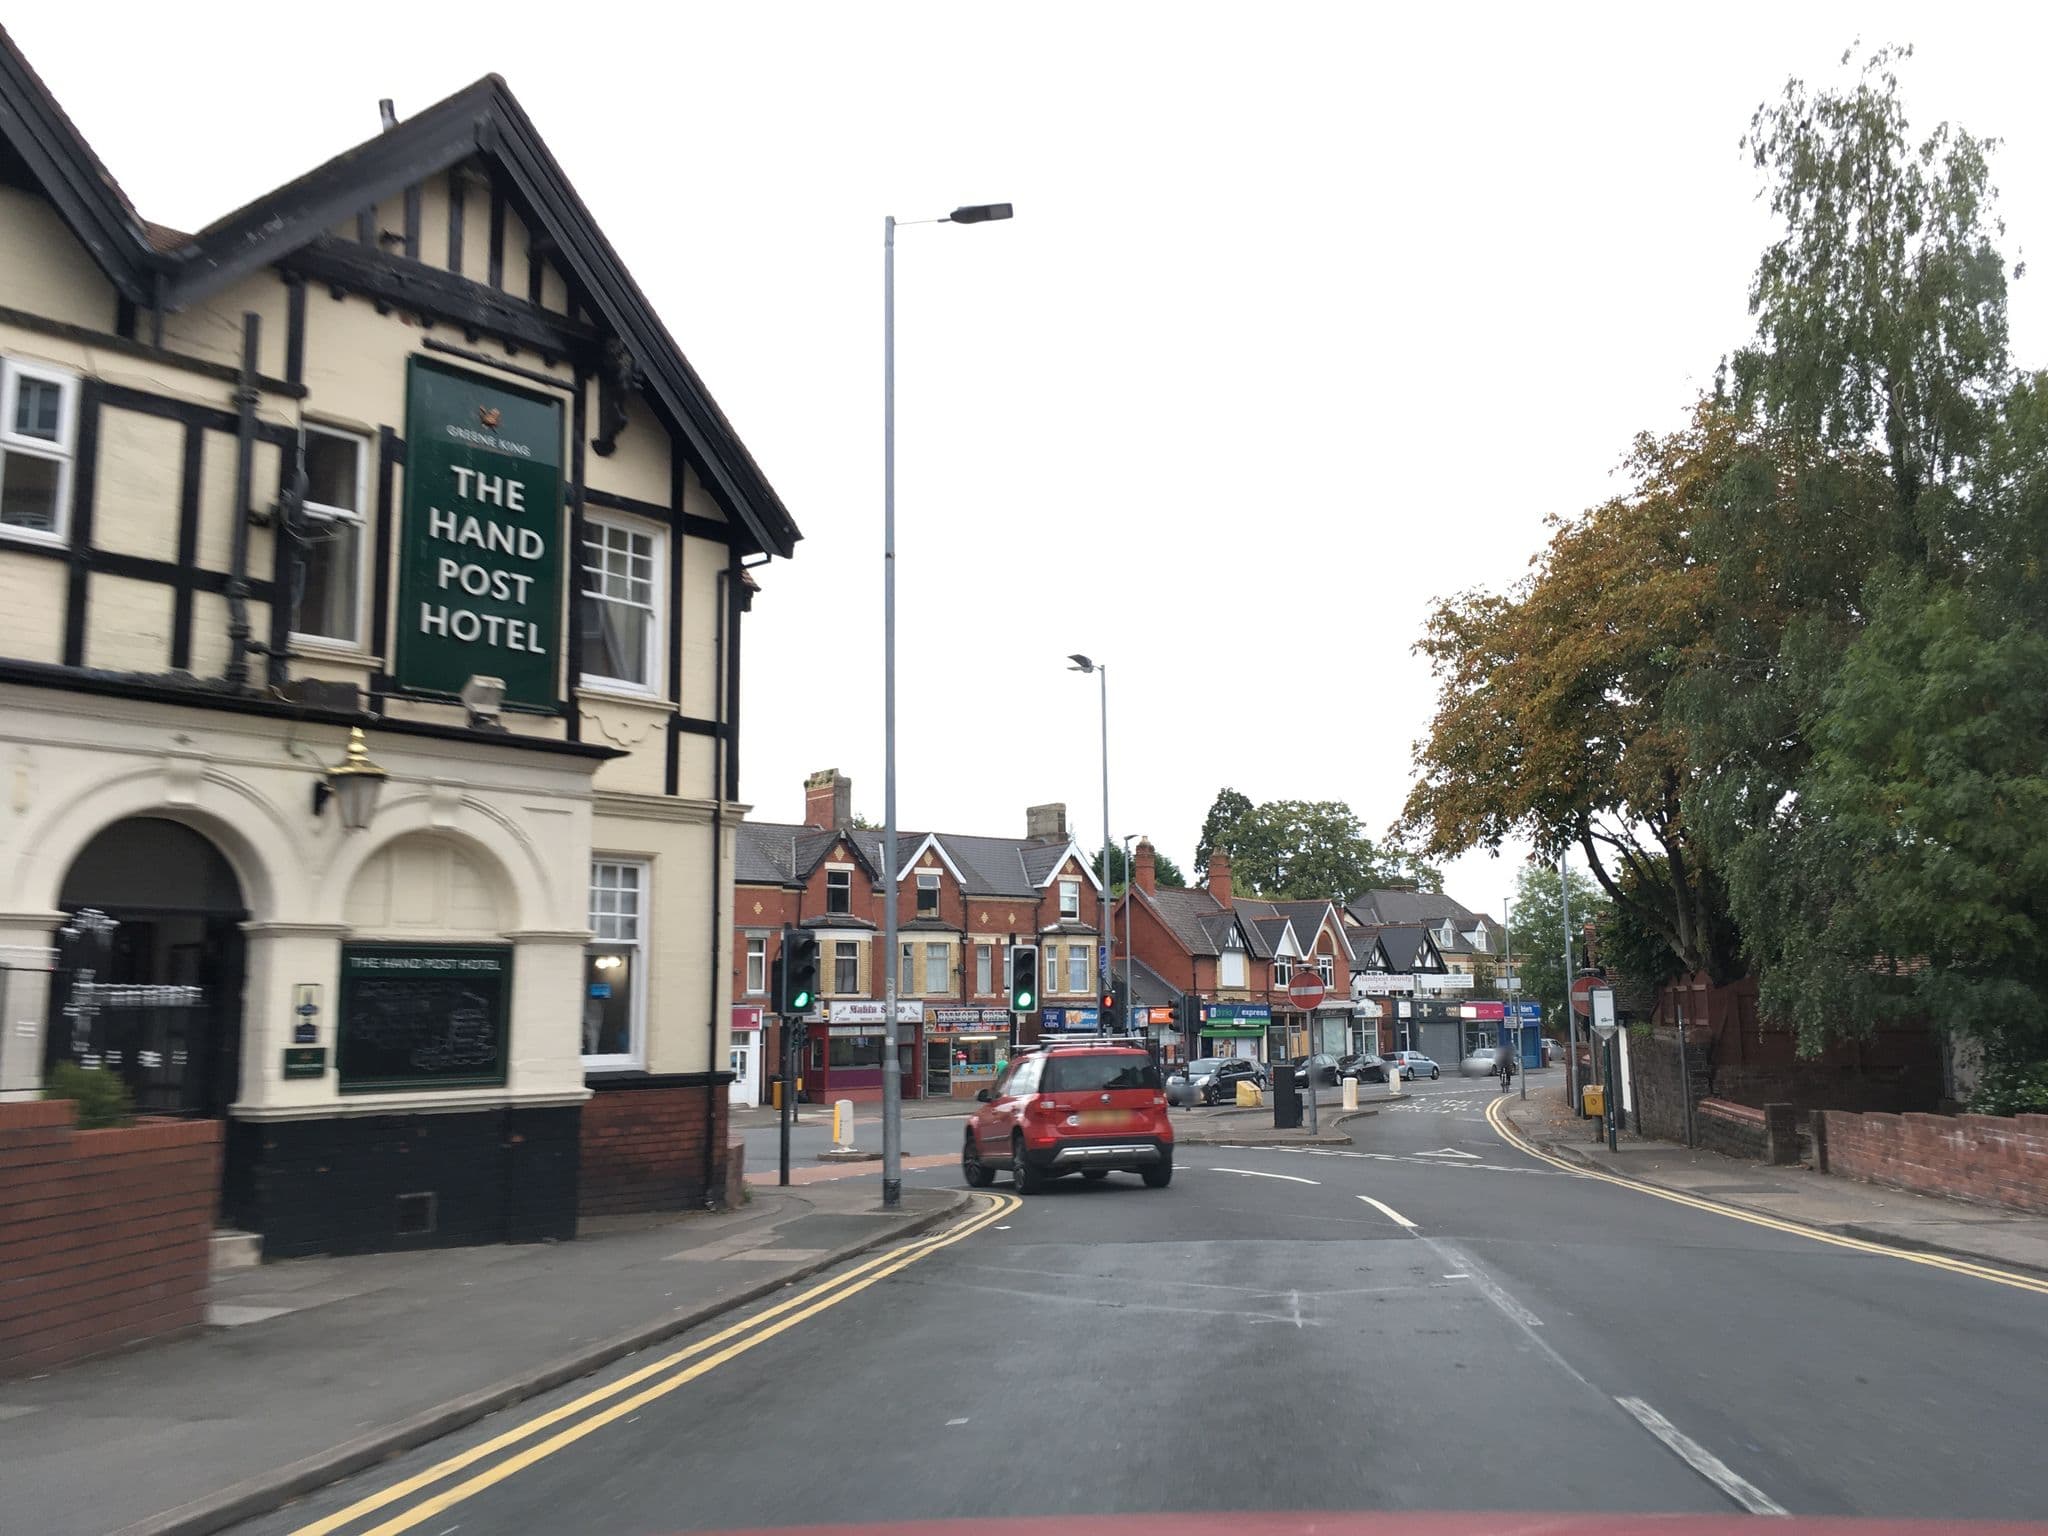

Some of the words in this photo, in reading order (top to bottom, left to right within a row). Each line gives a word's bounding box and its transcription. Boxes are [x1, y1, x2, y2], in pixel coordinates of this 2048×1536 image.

[446, 423, 498, 449] GREENE
[499, 437, 531, 457] KING
[450, 464, 526, 513] THE
[428, 505, 546, 561] HAND
[437, 556, 535, 606] POST
[419, 601, 547, 656] HOTEL
[349, 956, 380, 969] THE
[381, 957, 423, 969] HAND
[424, 957, 456, 970] POST
[457, 958, 501, 971] HOTEL
[1241, 1009, 1268, 1018] express
